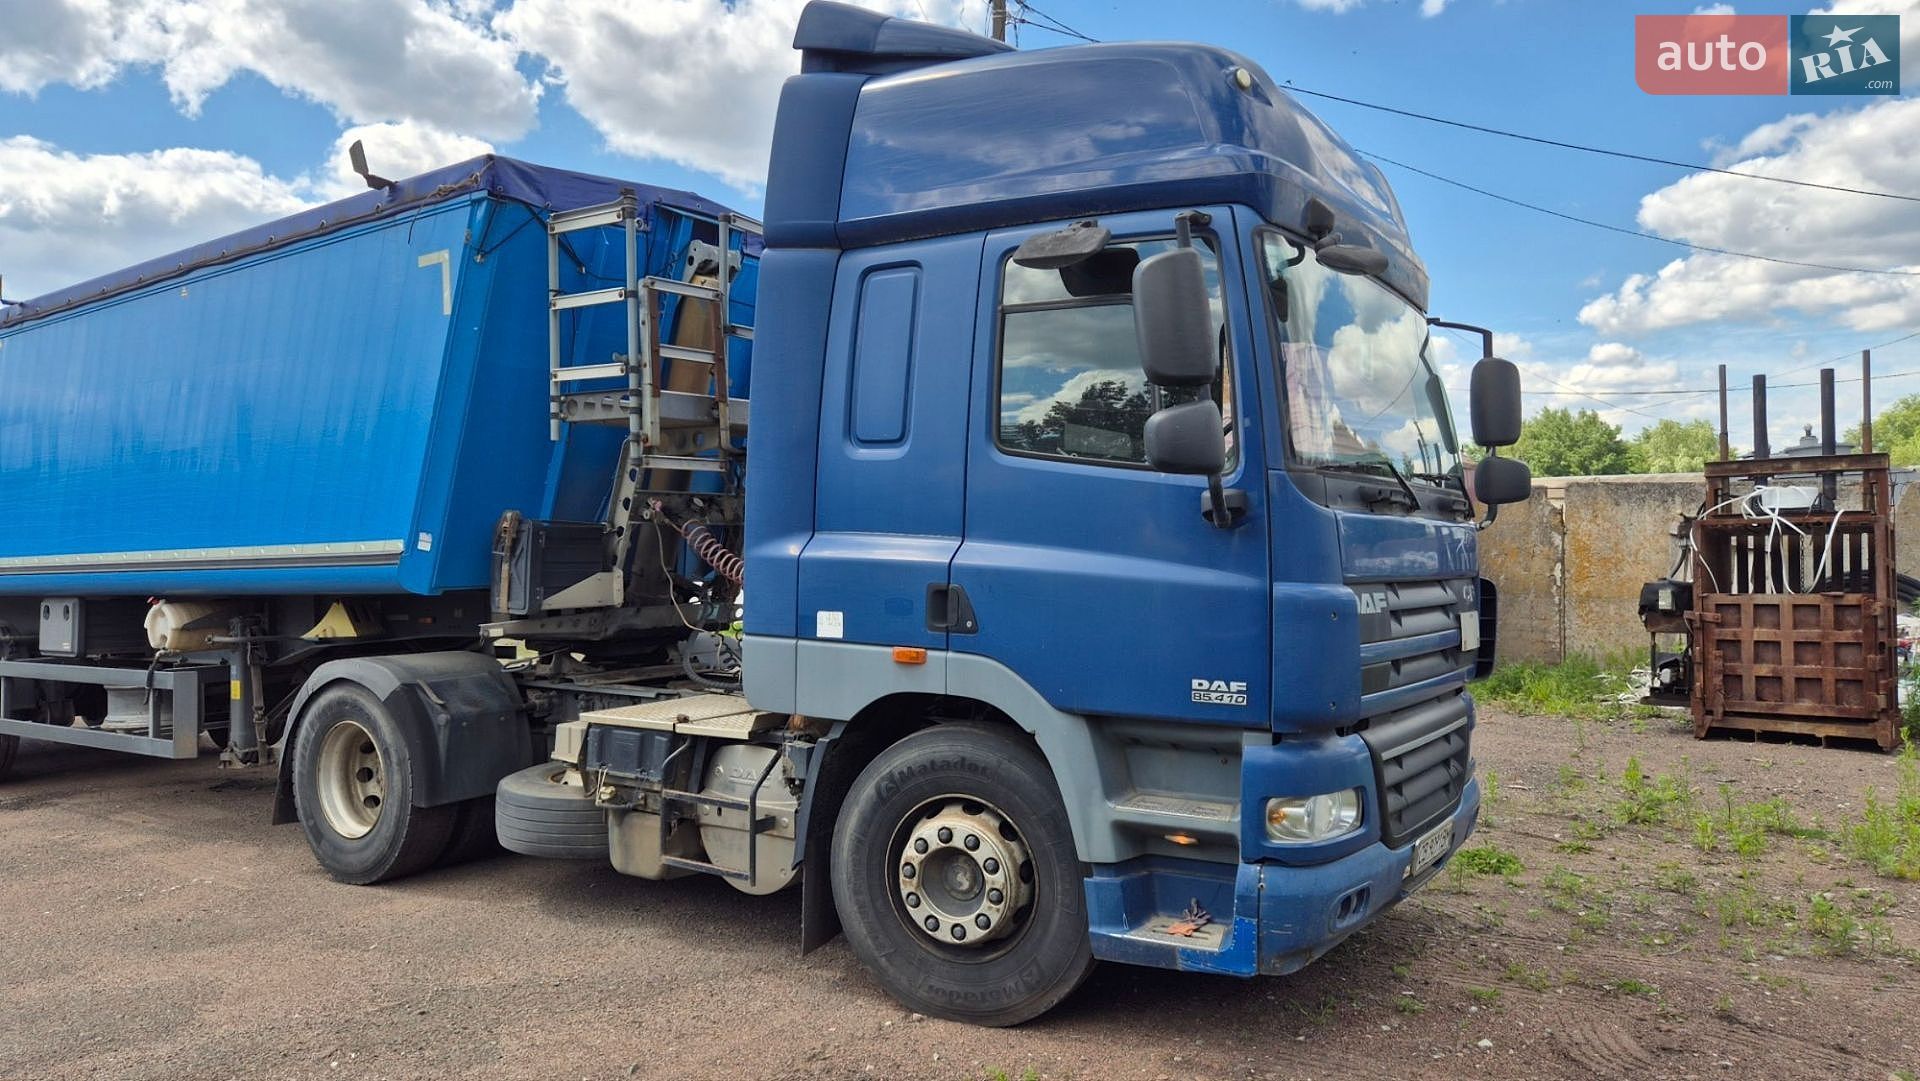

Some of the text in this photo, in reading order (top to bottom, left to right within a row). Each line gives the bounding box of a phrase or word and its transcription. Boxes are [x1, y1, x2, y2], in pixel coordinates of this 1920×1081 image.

[1360, 592, 1388, 614] AF
[1191, 678, 1247, 692] DAF
[898, 757, 992, 781] Matador
